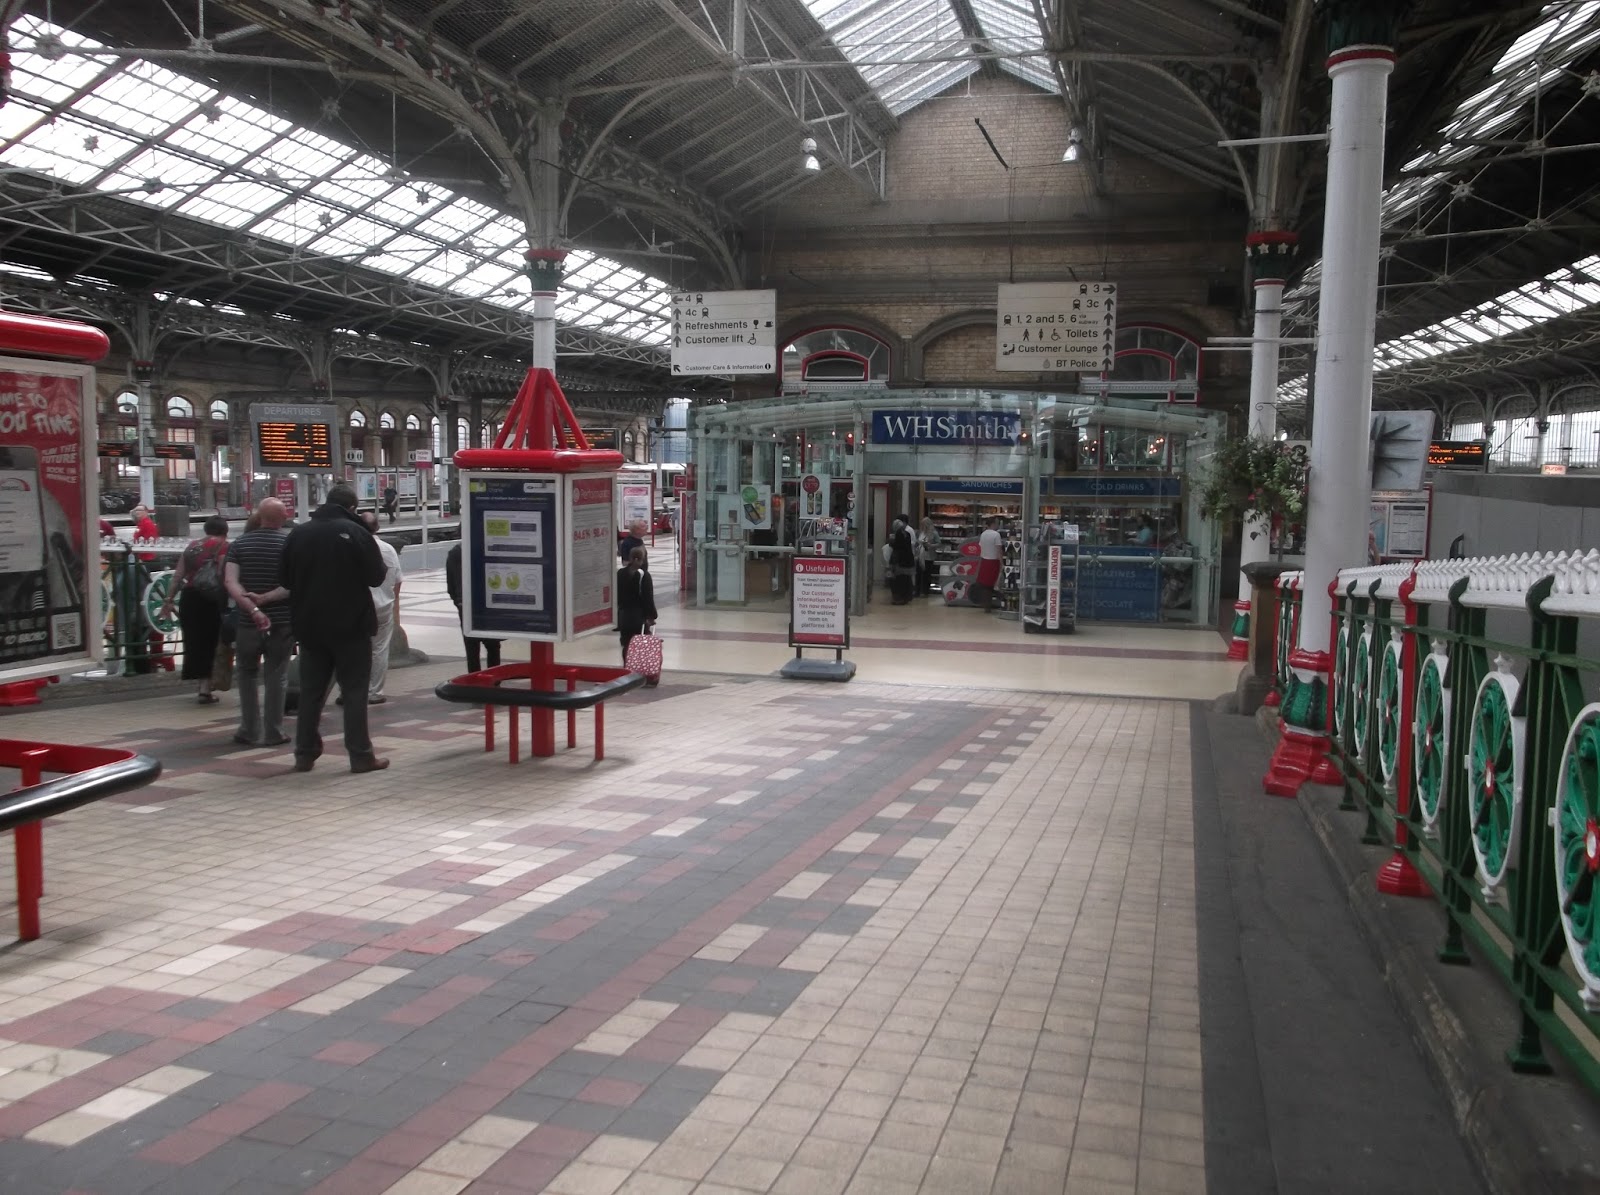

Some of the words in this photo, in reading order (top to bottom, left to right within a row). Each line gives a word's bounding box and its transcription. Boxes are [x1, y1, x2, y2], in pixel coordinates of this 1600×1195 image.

[1093, 284, 1100, 293] 3
[1086, 299, 1099, 308] 3c
[1026, 315, 1032, 323] 2
[1036, 315, 1055, 323] and
[1070, 314, 1077, 323] 6
[685, 320, 748, 330] Refreshments
[1065, 329, 1098, 338] Toilets
[685, 335, 729, 344] Customer
[732, 334, 744, 343] lift
[1018, 345, 1062, 353] Customer
[1064, 345, 1098, 354] Lounge
[1056, 360, 1067, 368] BT
[1070, 359, 1098, 368] Police
[264, 406, 322, 416] DEPARTURES
[883, 415, 1009, 439] WHSmith
[42, 453, 76, 463] FUTURE
[961, 481, 1012, 489] SANDWICHES
[1115, 483, 1144, 491] DRINKS
[1050, 547, 1059, 580] INDEPENDENT
[1049, 588, 1058, 621] INDEPENDENT
